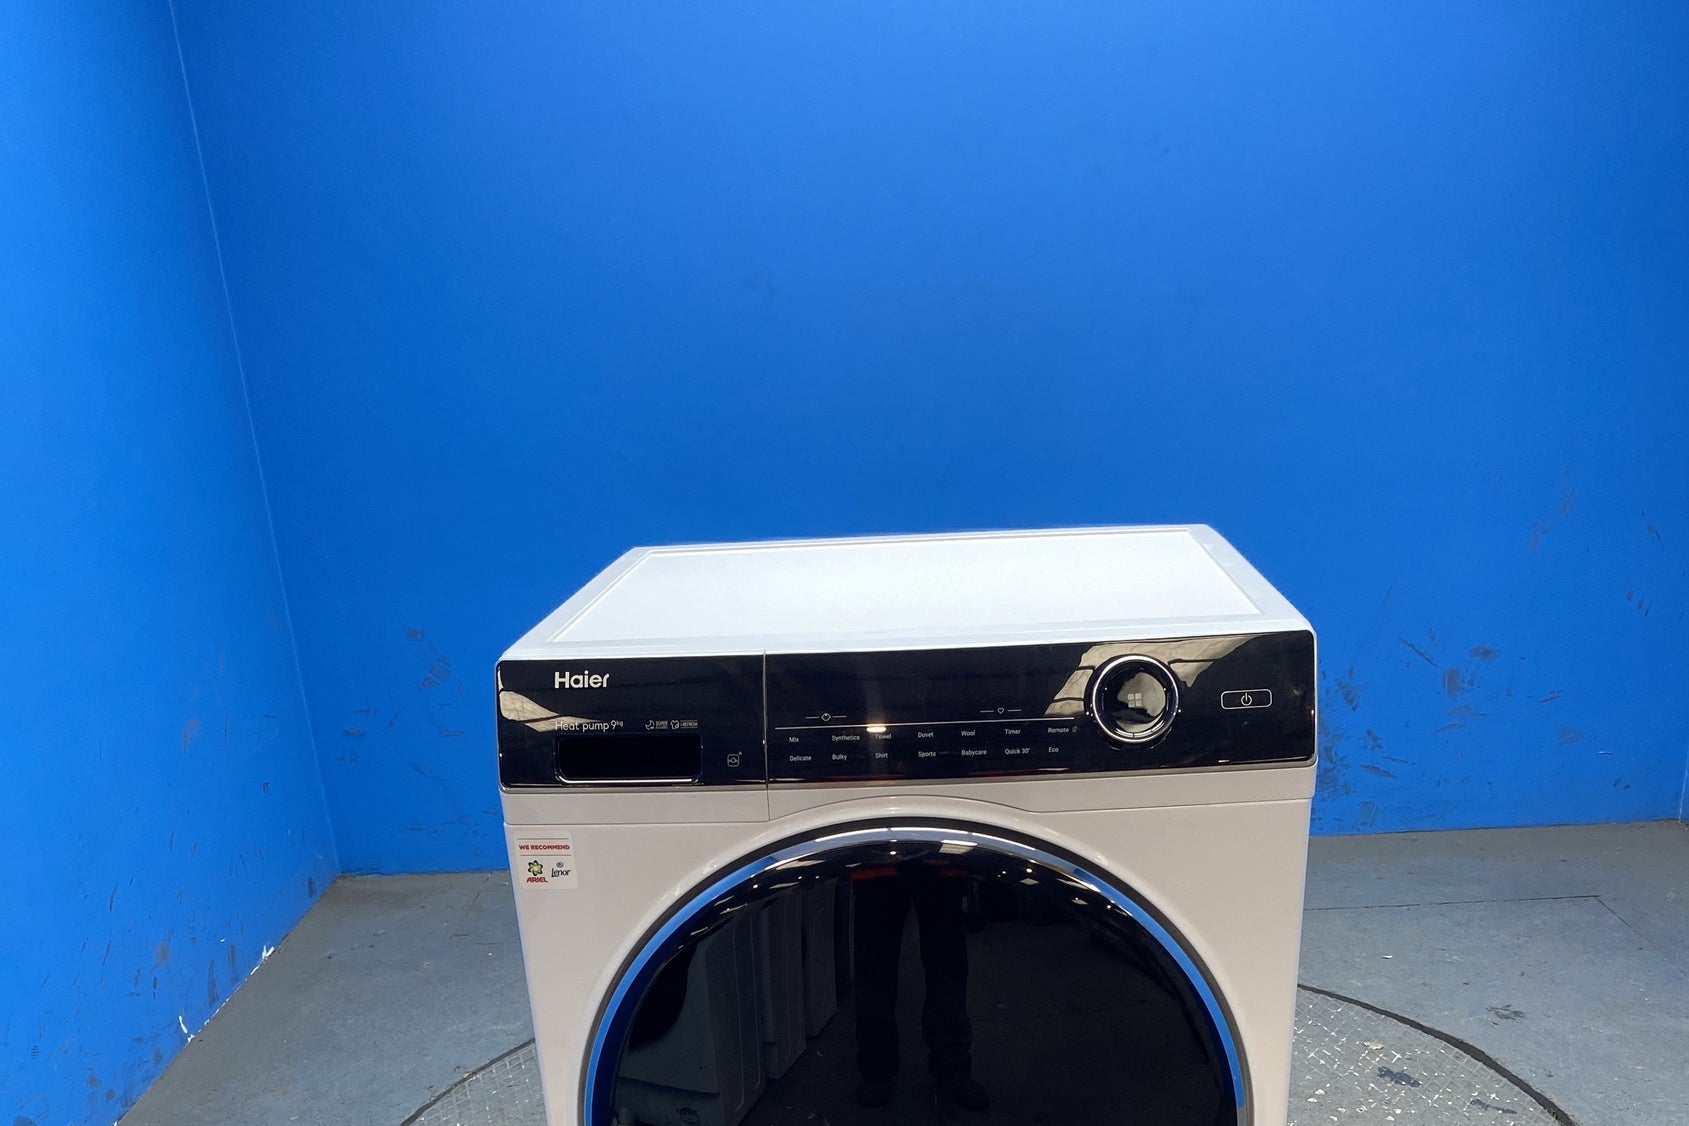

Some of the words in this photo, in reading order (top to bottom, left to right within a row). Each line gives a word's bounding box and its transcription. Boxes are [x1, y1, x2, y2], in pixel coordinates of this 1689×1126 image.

[554, 670, 610, 689] Haier
[554, 721, 580, 731] Heat
[582, 722, 610, 732] pump
[831, 734, 860, 742] Synthetics
[832, 753, 847, 762] Bulky
[918, 750, 937, 758] Sports
[961, 749, 987, 757] Babycare
[551, 867, 572, 878] Lenor
